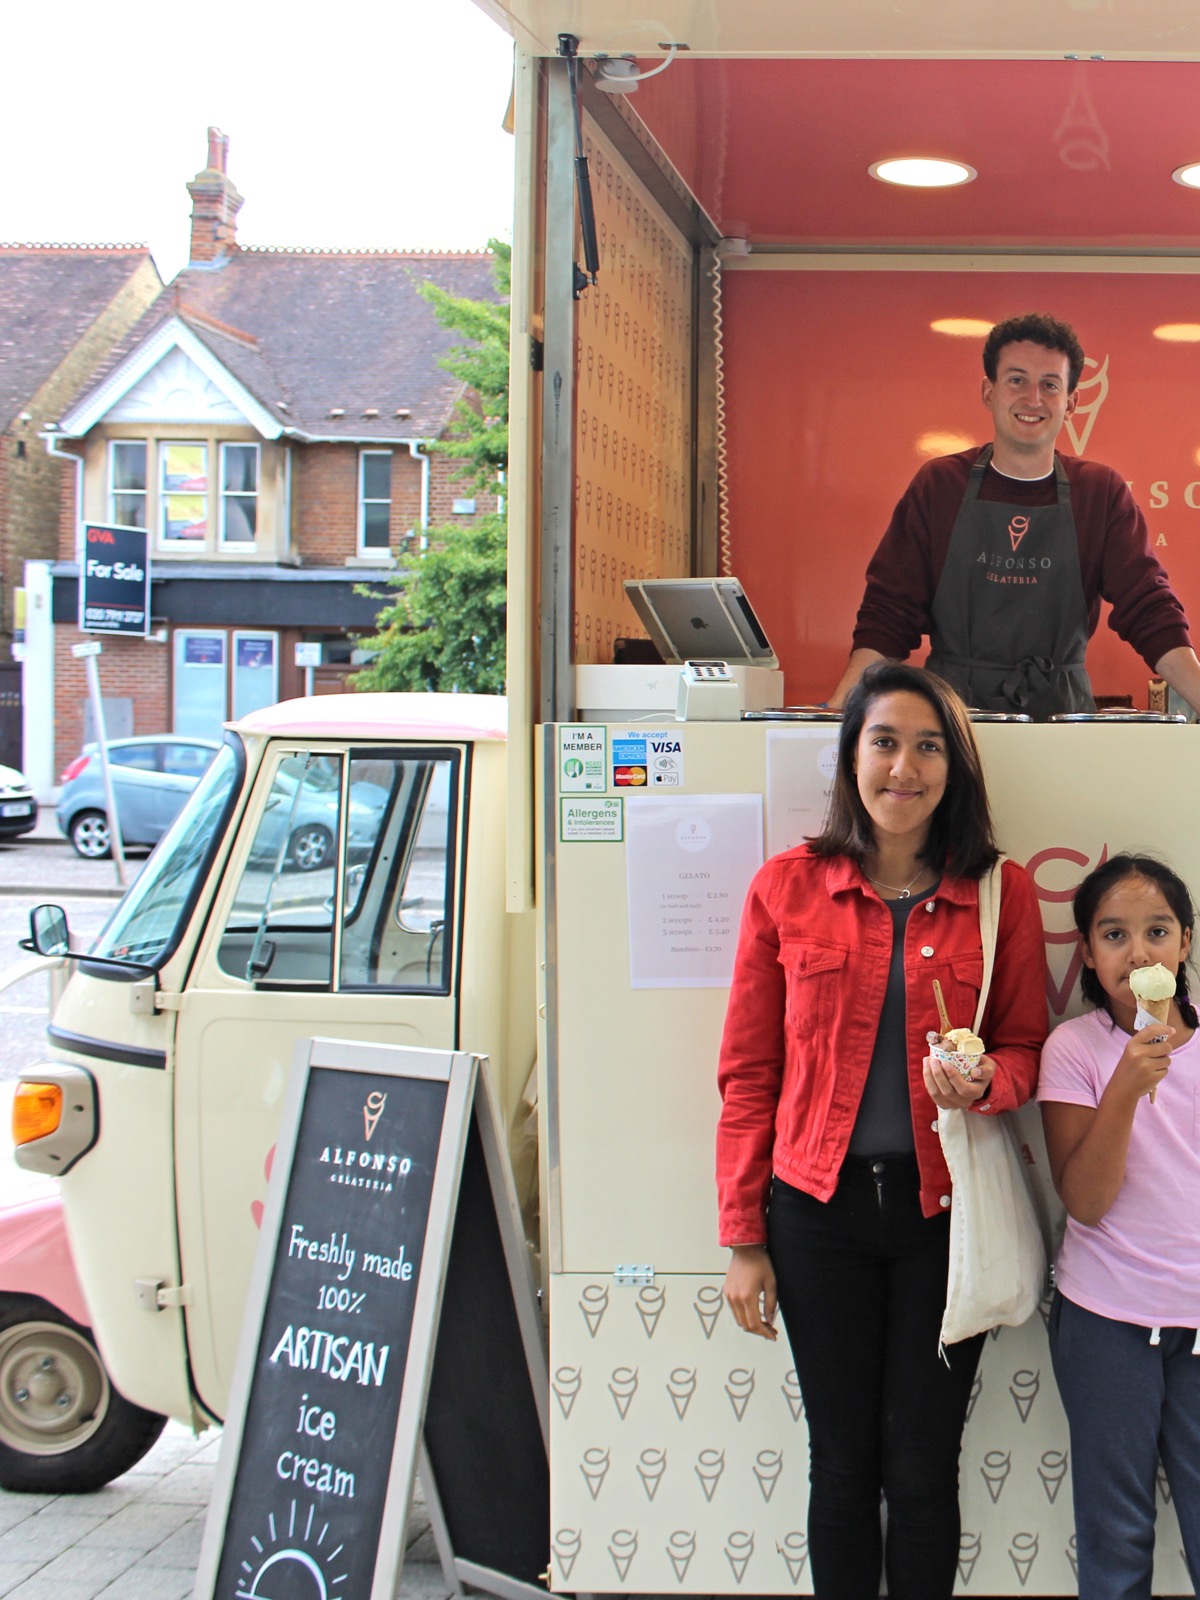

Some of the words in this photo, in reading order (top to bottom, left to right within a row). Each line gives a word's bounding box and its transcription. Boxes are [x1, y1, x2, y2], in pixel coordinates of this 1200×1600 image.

[87, 529, 115, 545] GVA
[86, 559, 112, 578] For
[113, 562, 144, 581] Sale
[643, 731, 668, 740] accept
[563, 743, 603, 751] MEMBER
[650, 742, 681, 753] VISA
[663, 775, 677, 783] Pay
[567, 809, 618, 819] Allergens
[320, 1147, 412, 1174] ALFONSO
[330, 1174, 393, 1192] GELATERIA
[288, 1224, 356, 1281] Freshly
[362, 1245, 413, 1281] made
[317, 1285, 367, 1314] 100%
[269, 1324, 390, 1387] ARTISAN
[296, 1393, 336, 1441] ice
[276, 1451, 355, 1498] cream
